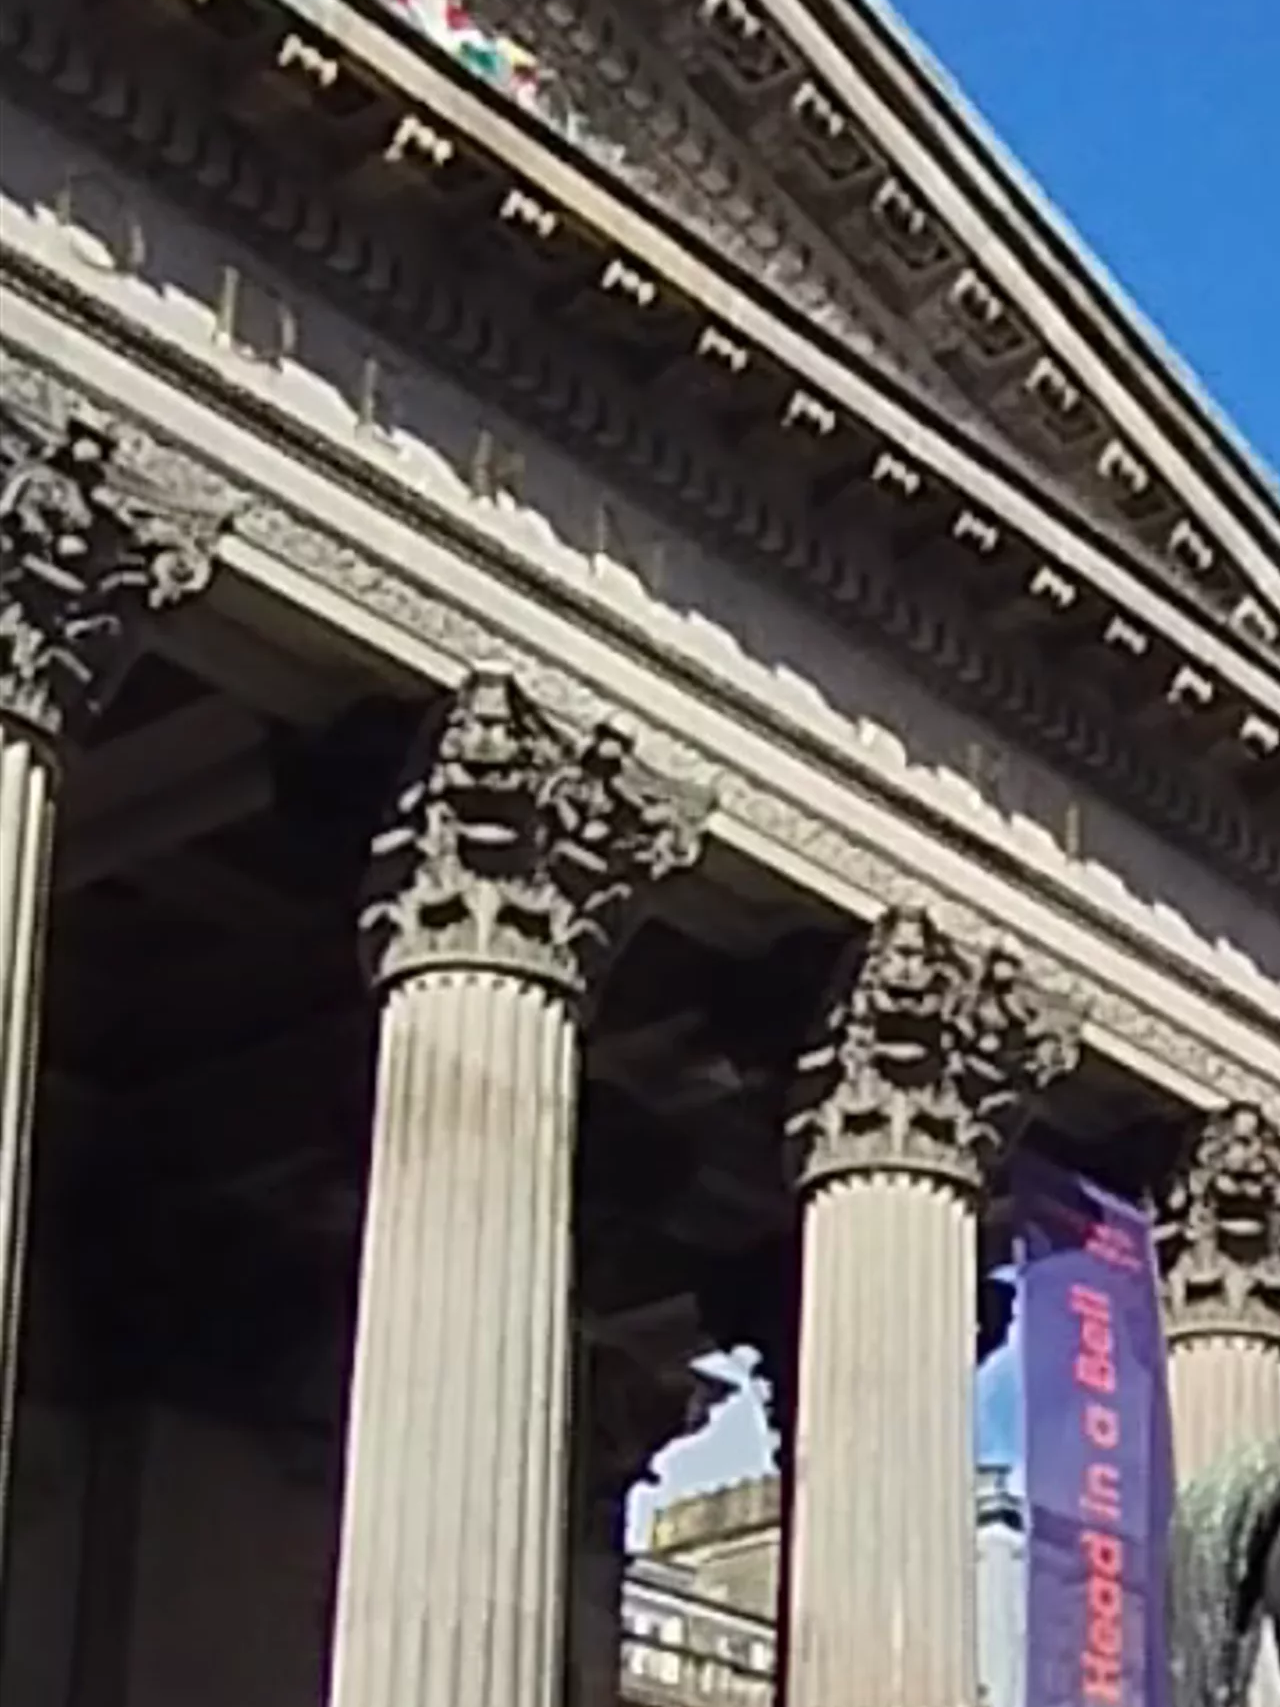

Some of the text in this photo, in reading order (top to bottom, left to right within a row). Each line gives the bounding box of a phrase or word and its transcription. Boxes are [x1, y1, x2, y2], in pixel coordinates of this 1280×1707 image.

[1070, 1284, 1117, 1392] Bell
[1082, 1404, 1120, 1449] a
[1080, 1463, 1120, 1519] in
[1080, 1531, 1121, 1701] Head
